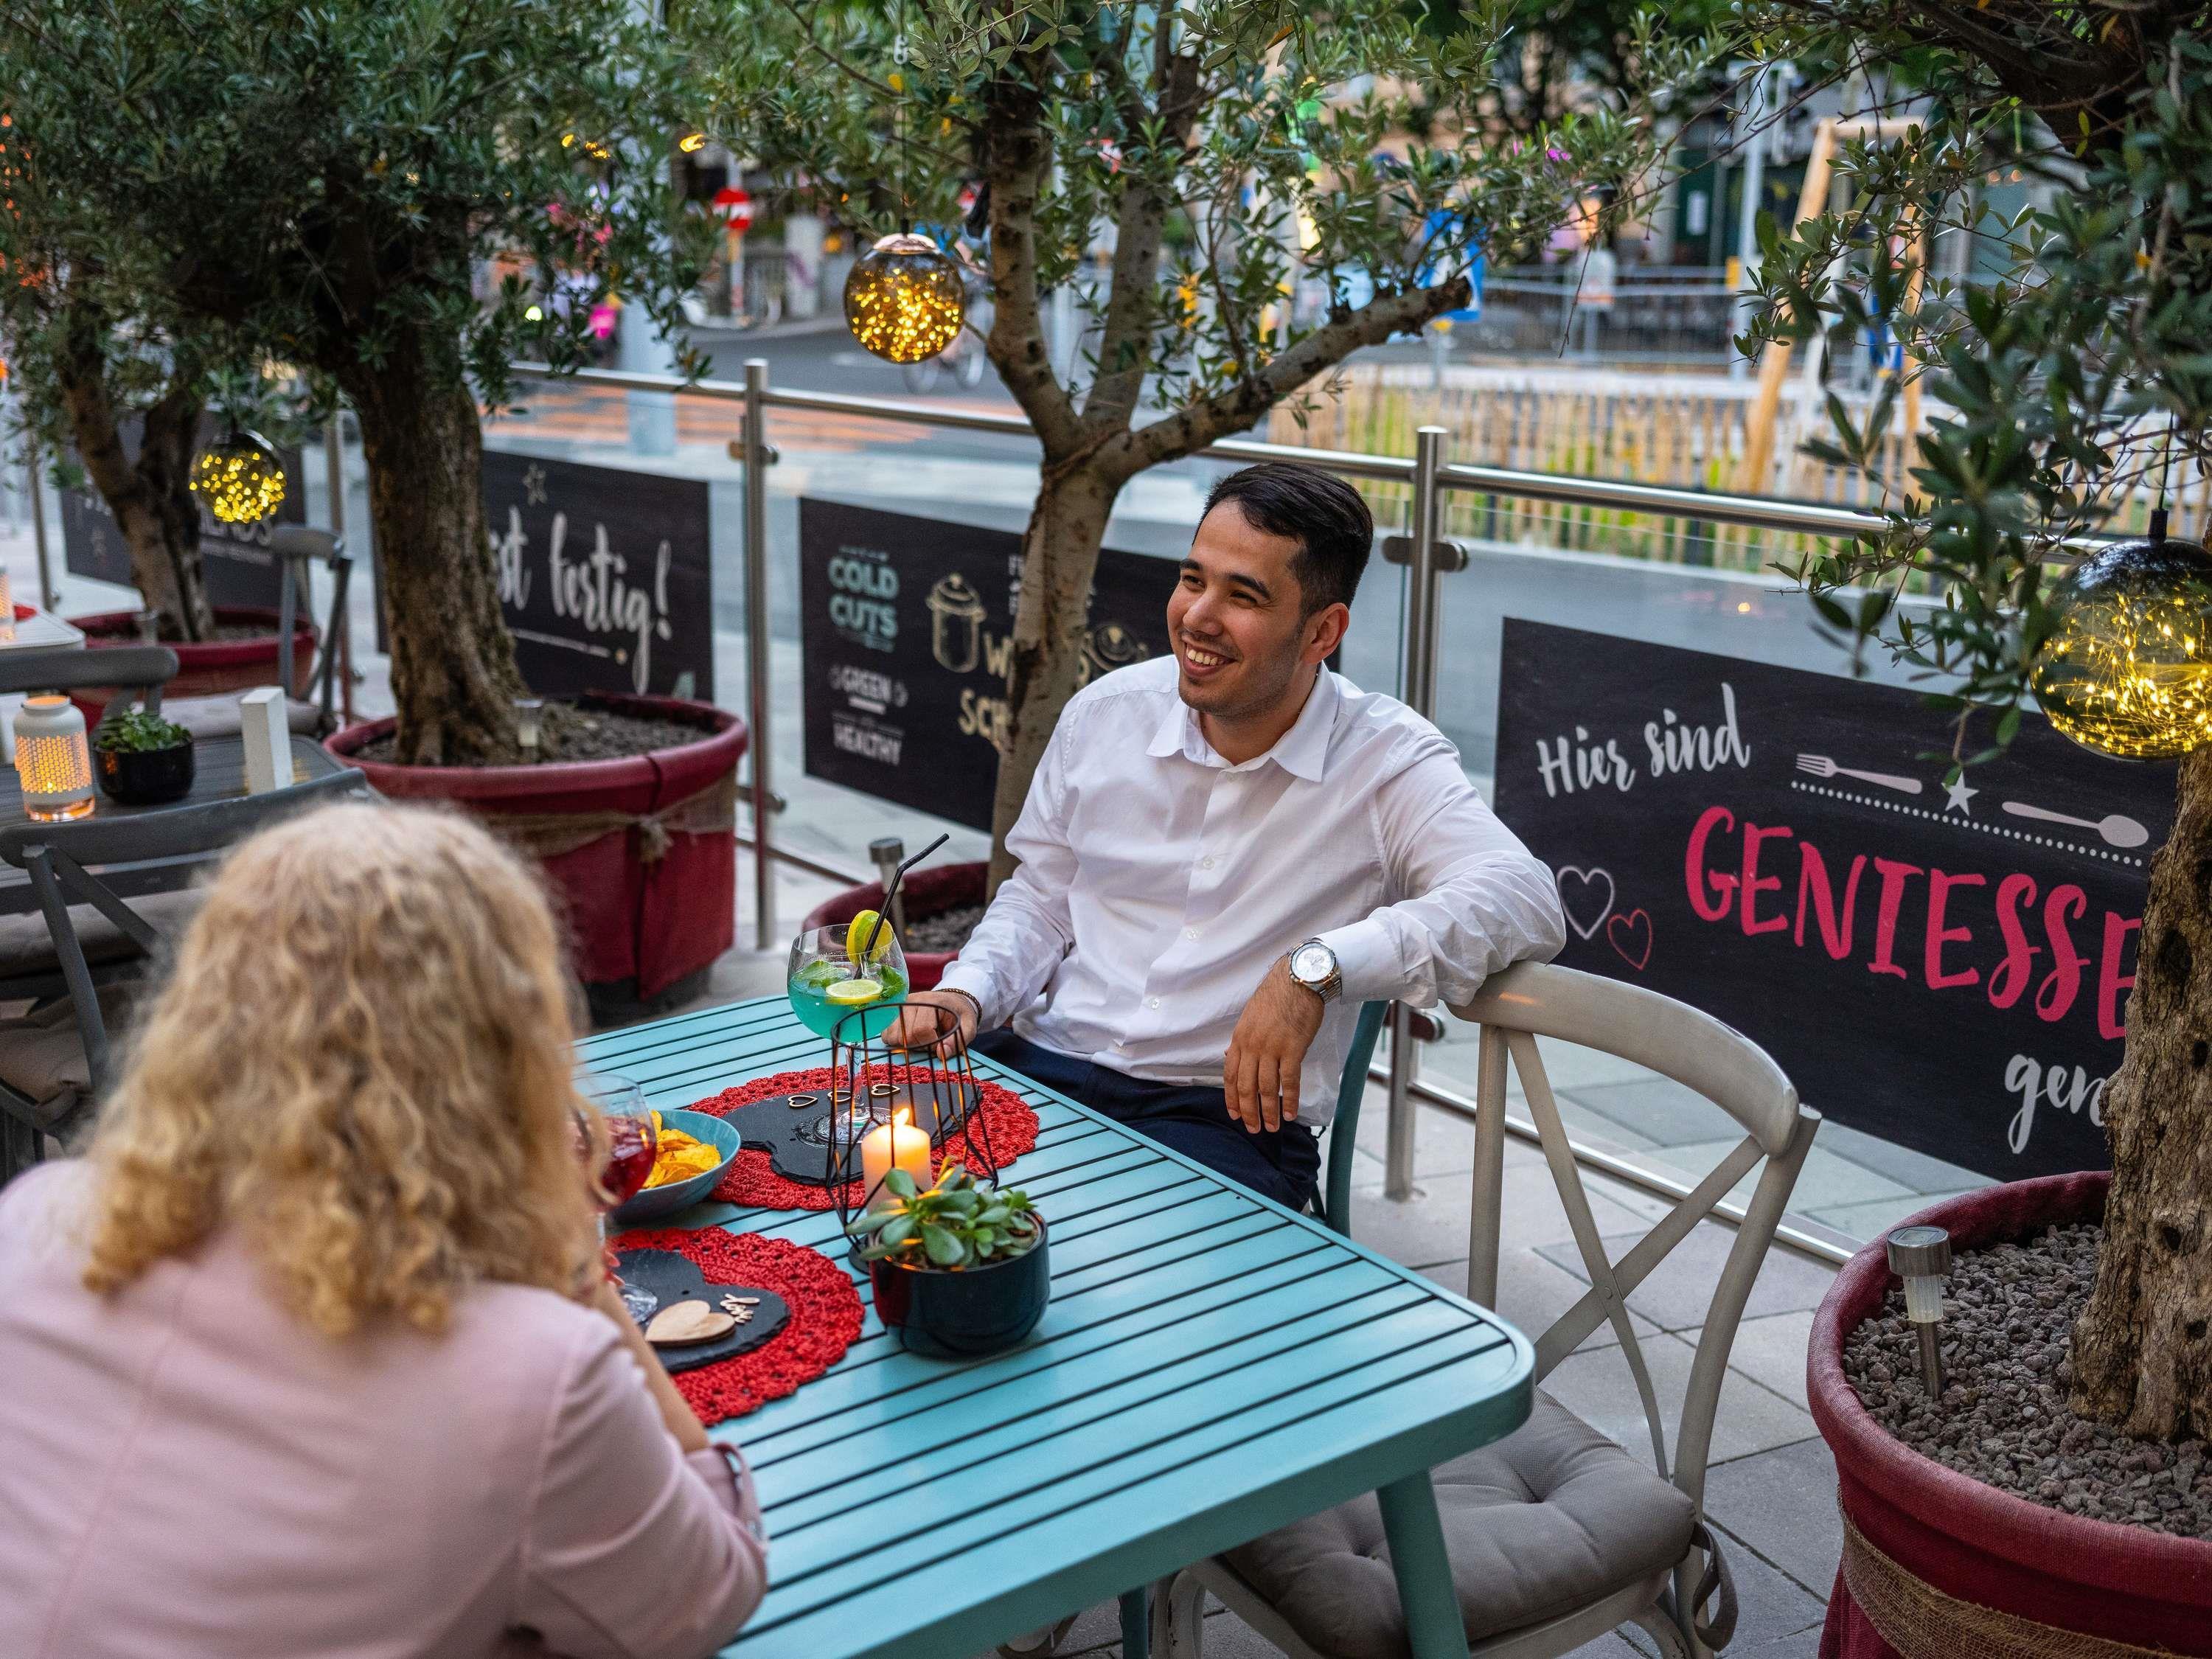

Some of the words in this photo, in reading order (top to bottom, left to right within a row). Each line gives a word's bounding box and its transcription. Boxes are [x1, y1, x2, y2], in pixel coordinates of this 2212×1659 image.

[828, 556, 900, 600] COLD
[830, 594, 898, 639] CUTS
[833, 722, 902, 765] HEALTHY
[1536, 725, 1636, 798] Hier
[1644, 682, 1751, 778] sind
[1685, 806, 2143, 1040] GENIESSE
[2004, 1054, 2107, 1155] gen
